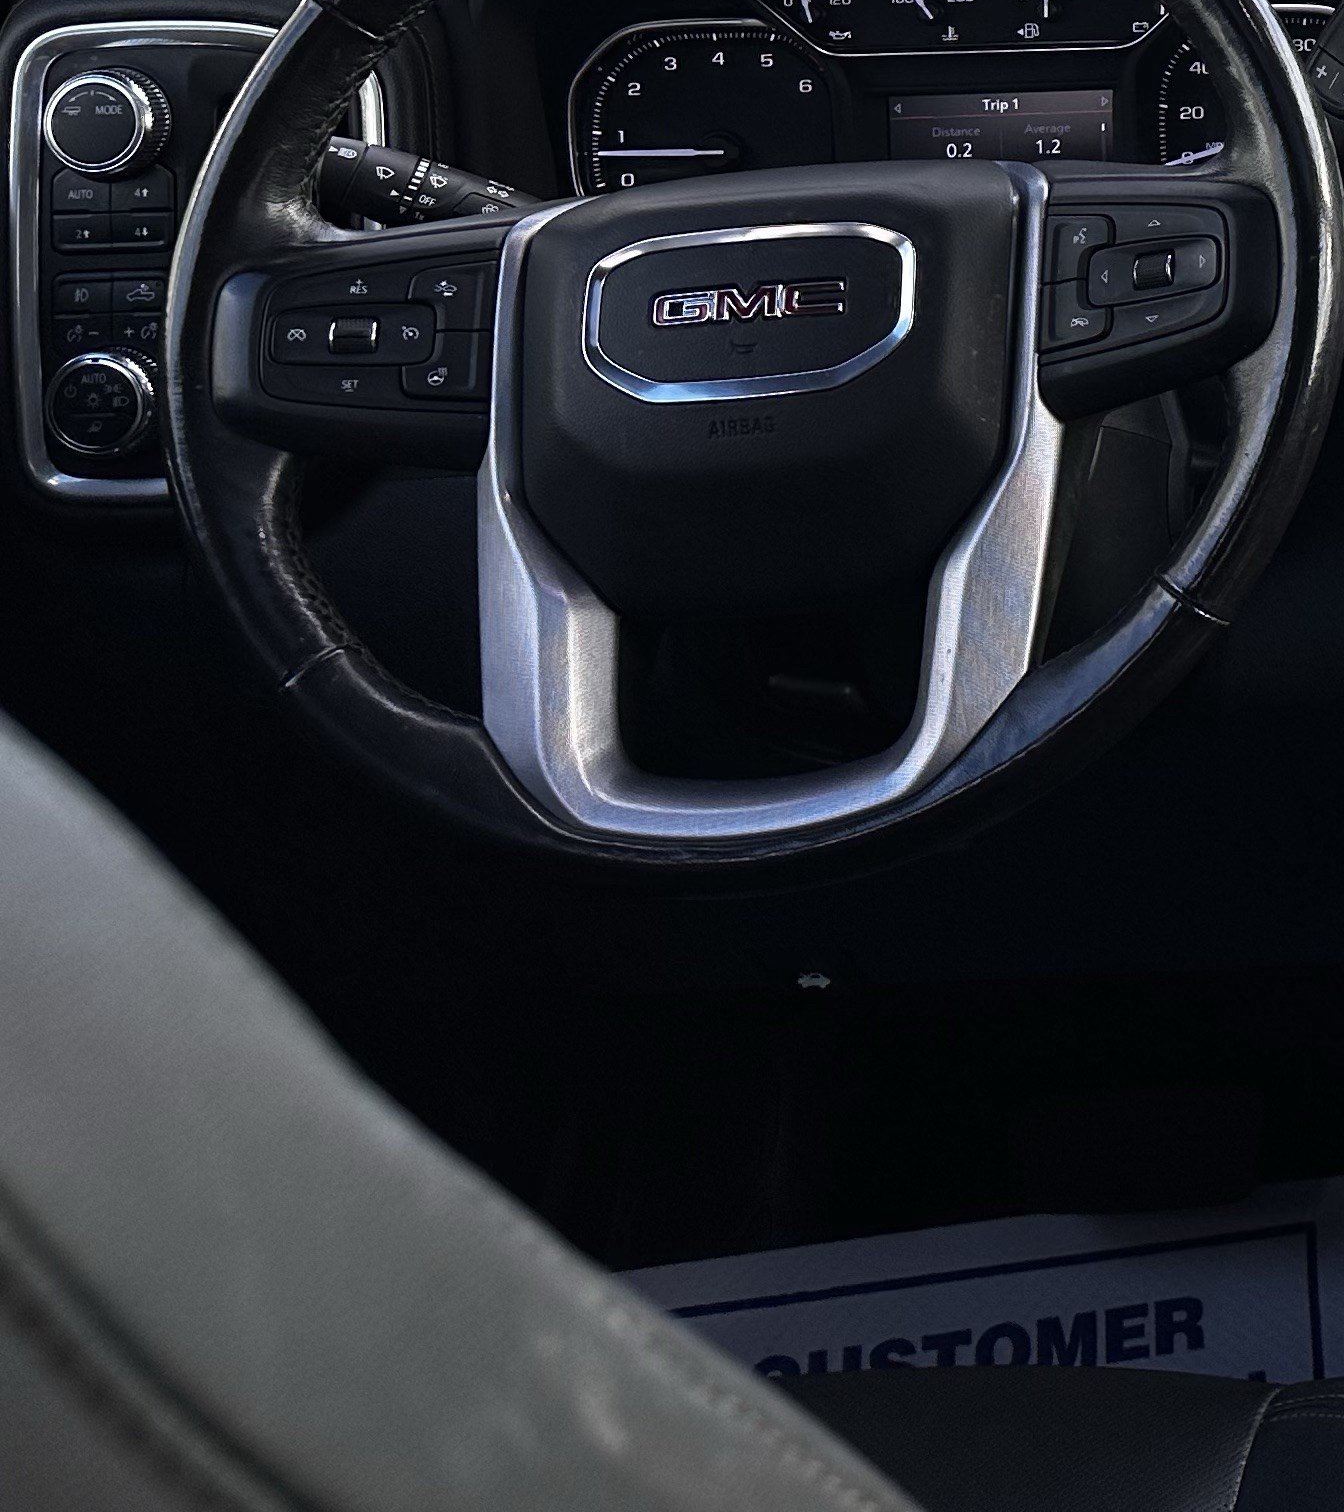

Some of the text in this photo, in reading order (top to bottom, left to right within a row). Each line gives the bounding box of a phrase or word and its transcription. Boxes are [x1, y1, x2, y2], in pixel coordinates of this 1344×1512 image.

[663, 56, 677, 71] 3
[711, 51, 725, 66] 4
[760, 53, 774, 68] 5
[628, 82, 641, 96] 2
[799, 79, 813, 93] 6
[95, 104, 123, 115] MODE
[982, 98, 1020, 113] Trip 1
[1179, 105, 1205, 120] 20
[617, 129, 624, 143] 1
[932, 126, 981, 137] Distance
[1024, 123, 1071, 136] Average
[946, 142, 973, 158] 0.2
[1035, 139, 1062, 154] 1.2
[621, 173, 634, 187] 0
[68, 189, 93, 200] AUTO
[418, 194, 437, 207] OFF
[350, 284, 368, 295] RES
[653, 280, 845, 327] GMC
[81, 373, 107, 384] AUTO
[341, 379, 359, 390] SET
[708, 417, 776, 438] AIRBAG
